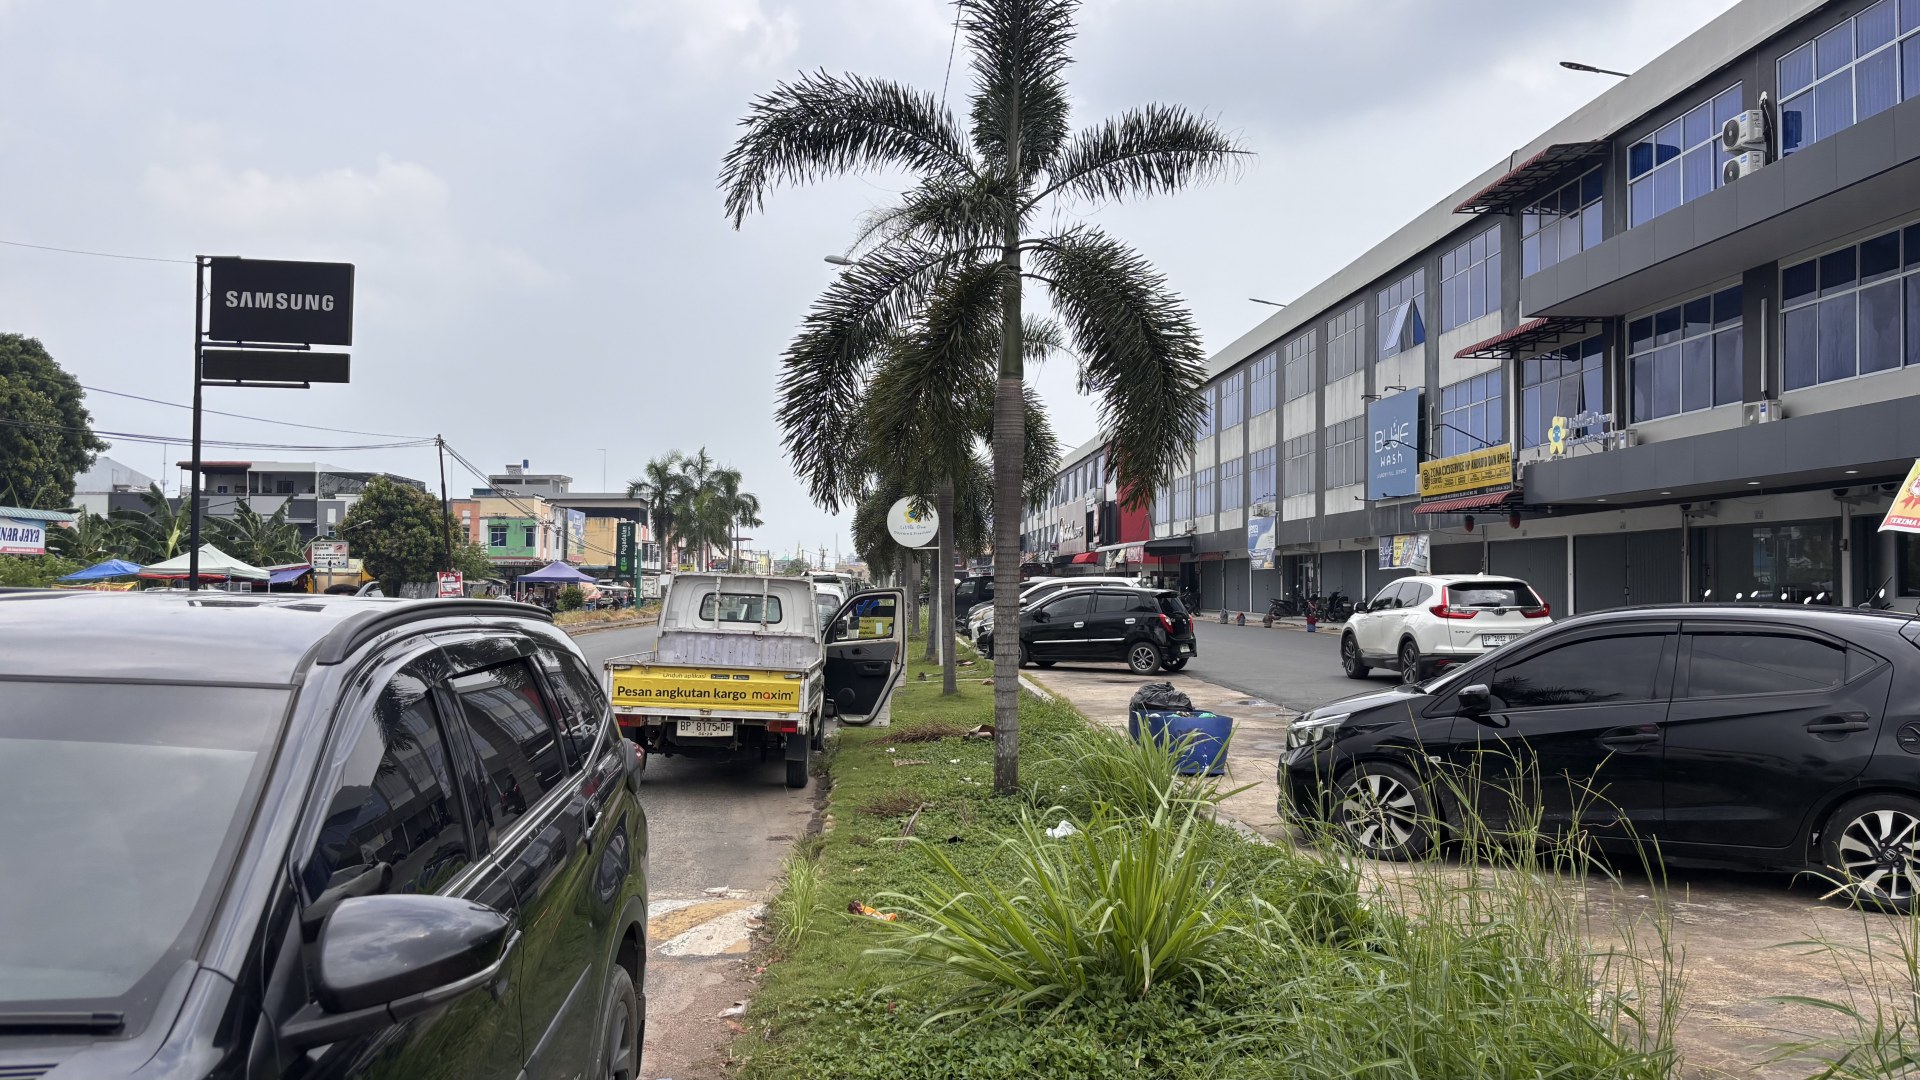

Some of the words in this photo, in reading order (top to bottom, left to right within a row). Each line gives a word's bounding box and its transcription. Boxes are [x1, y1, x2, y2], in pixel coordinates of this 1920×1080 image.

[225, 291, 334, 312] SAMSUNG
[1889, 517, 1916, 527] TERIMA
[0, 527, 18, 542] NAR
[19, 528, 40, 542] JAYA
[617, 686, 652, 697] Pesan
[655, 687, 710, 700] angkutan
[714, 688, 747, 701] kargo
[752, 690, 793, 700] maxim
[680, 721, 692, 731] BP
[696, 722, 717, 732] 8175
